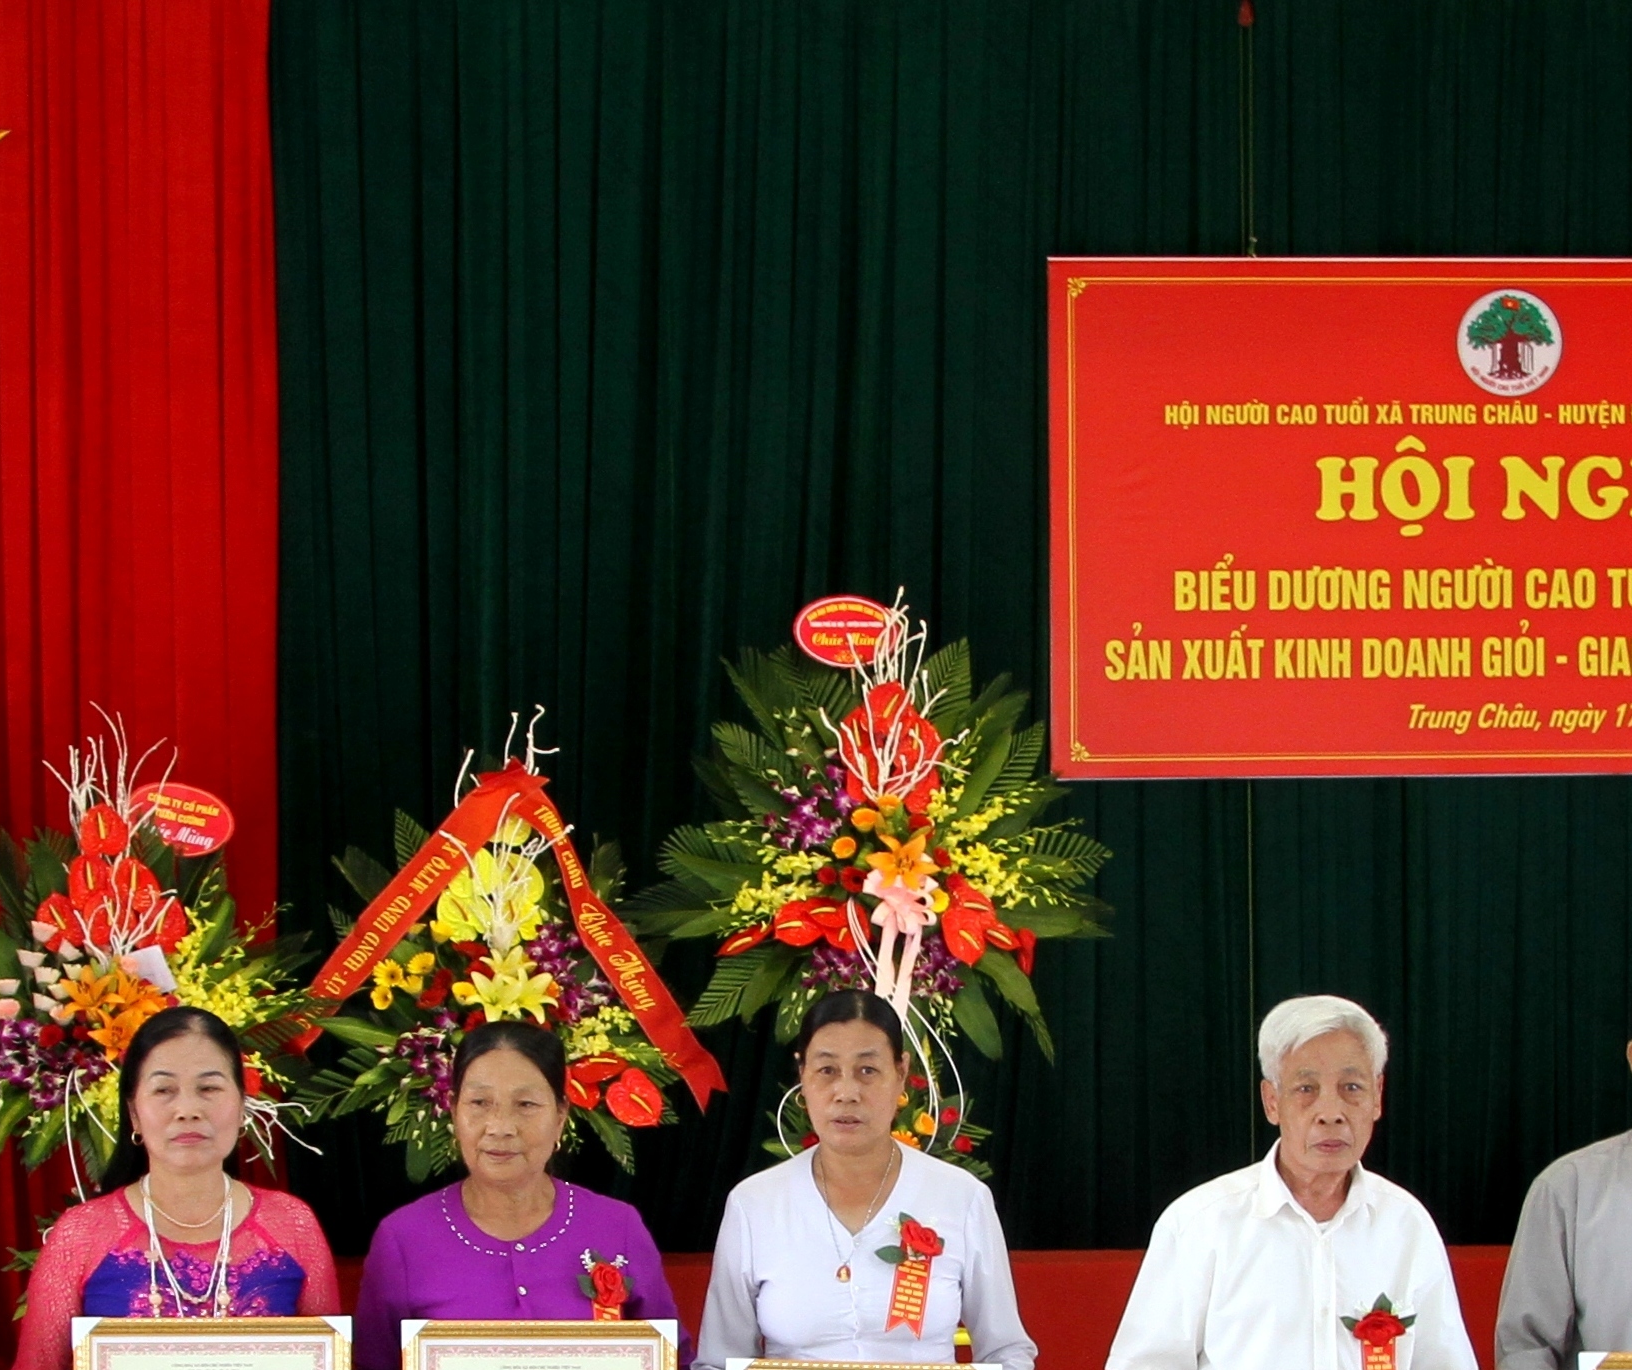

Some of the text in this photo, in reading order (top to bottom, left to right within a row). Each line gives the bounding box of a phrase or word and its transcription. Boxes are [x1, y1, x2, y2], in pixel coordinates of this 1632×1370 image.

[1164, 400, 1200, 430] HỘI
[1205, 398, 1270, 426] NGƯỜI
[1276, 404, 1318, 425] CAO
[1323, 396, 1370, 425] TUỔI
[1376, 400, 1404, 425] XÃ
[1409, 403, 1477, 425] TRUNG
[1482, 397, 1538, 425] CHÂU
[1558, 399, 1626, 429] HUYỆN
[1315, 434, 1476, 537] HỘI
[1174, 552, 1257, 612] BIỂU
[1268, 565, 1391, 611] DƯƠNG
[1403, 557, 1513, 610] NGƯỜI
[1525, 567, 1596, 610] CAO
[1104, 621, 1172, 681] SẢN
[1181, 623, 1265, 681] XUẤT
[1274, 637, 1352, 679] KINH
[1361, 637, 1472, 679] DOANH
[1481, 618, 1546, 678] GIỎI
[1408, 703, 1473, 735] Trung
[1477, 702, 1542, 732] Châu,
[1549, 702, 1608, 734] ngày
[373, 896, 412, 934] UBND
[408, 856, 451, 895] MTTQ
